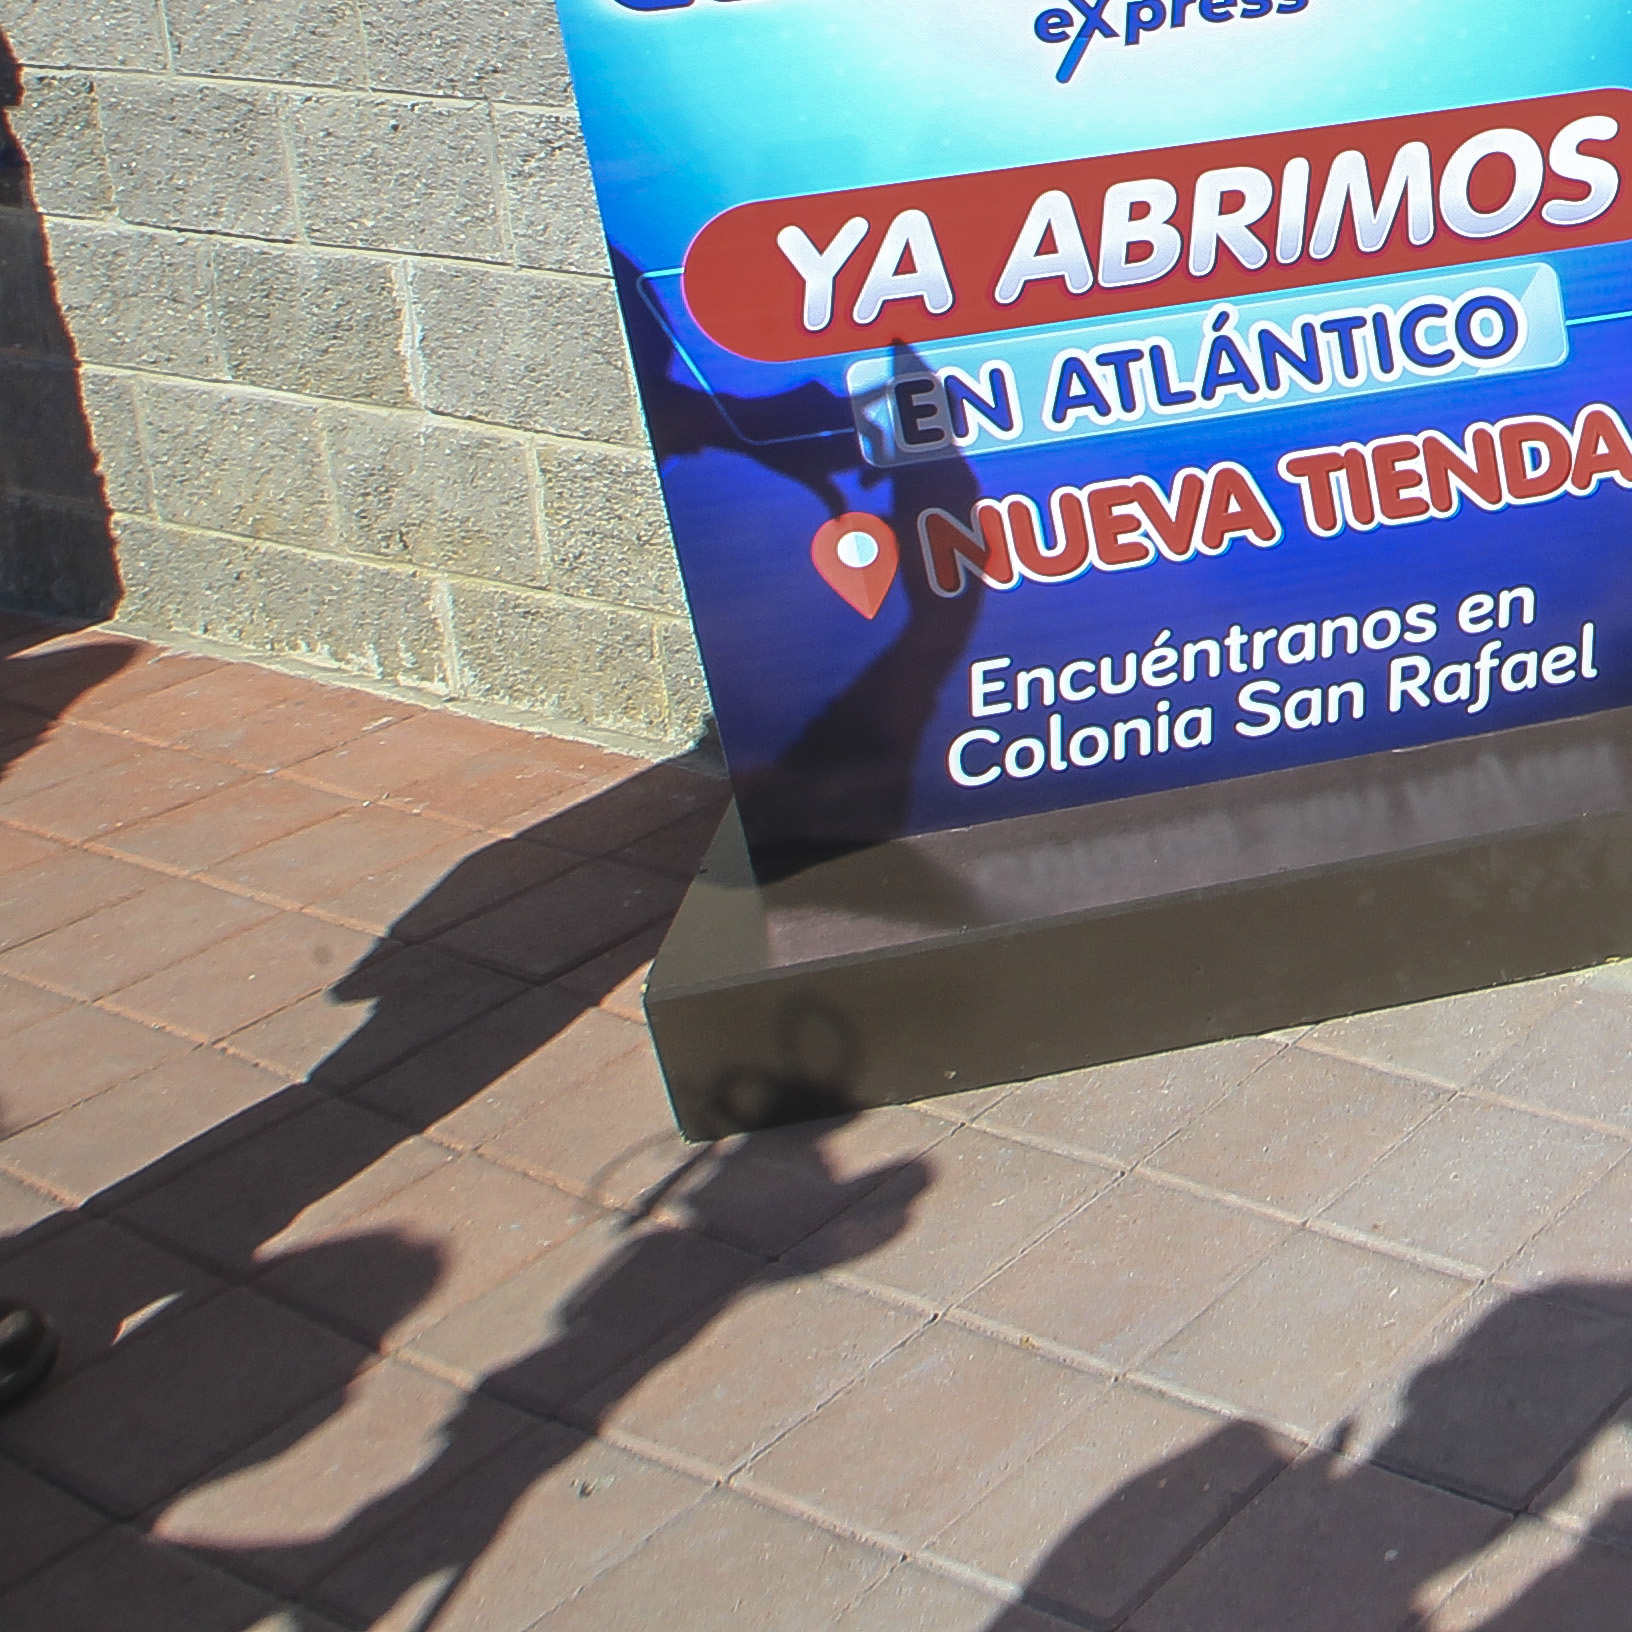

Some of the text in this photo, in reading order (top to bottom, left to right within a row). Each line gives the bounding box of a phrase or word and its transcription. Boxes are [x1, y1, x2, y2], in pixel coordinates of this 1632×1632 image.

[776, 115, 1621, 331] YA ABRIMOS
[893, 293, 1522, 450] EN ATLÁNTICO
[921, 464, 1279, 595] NUEVA
[946, 623, 1598, 788] Colonia San Rafael
[970, 585, 1537, 718] Encuéntranos en
